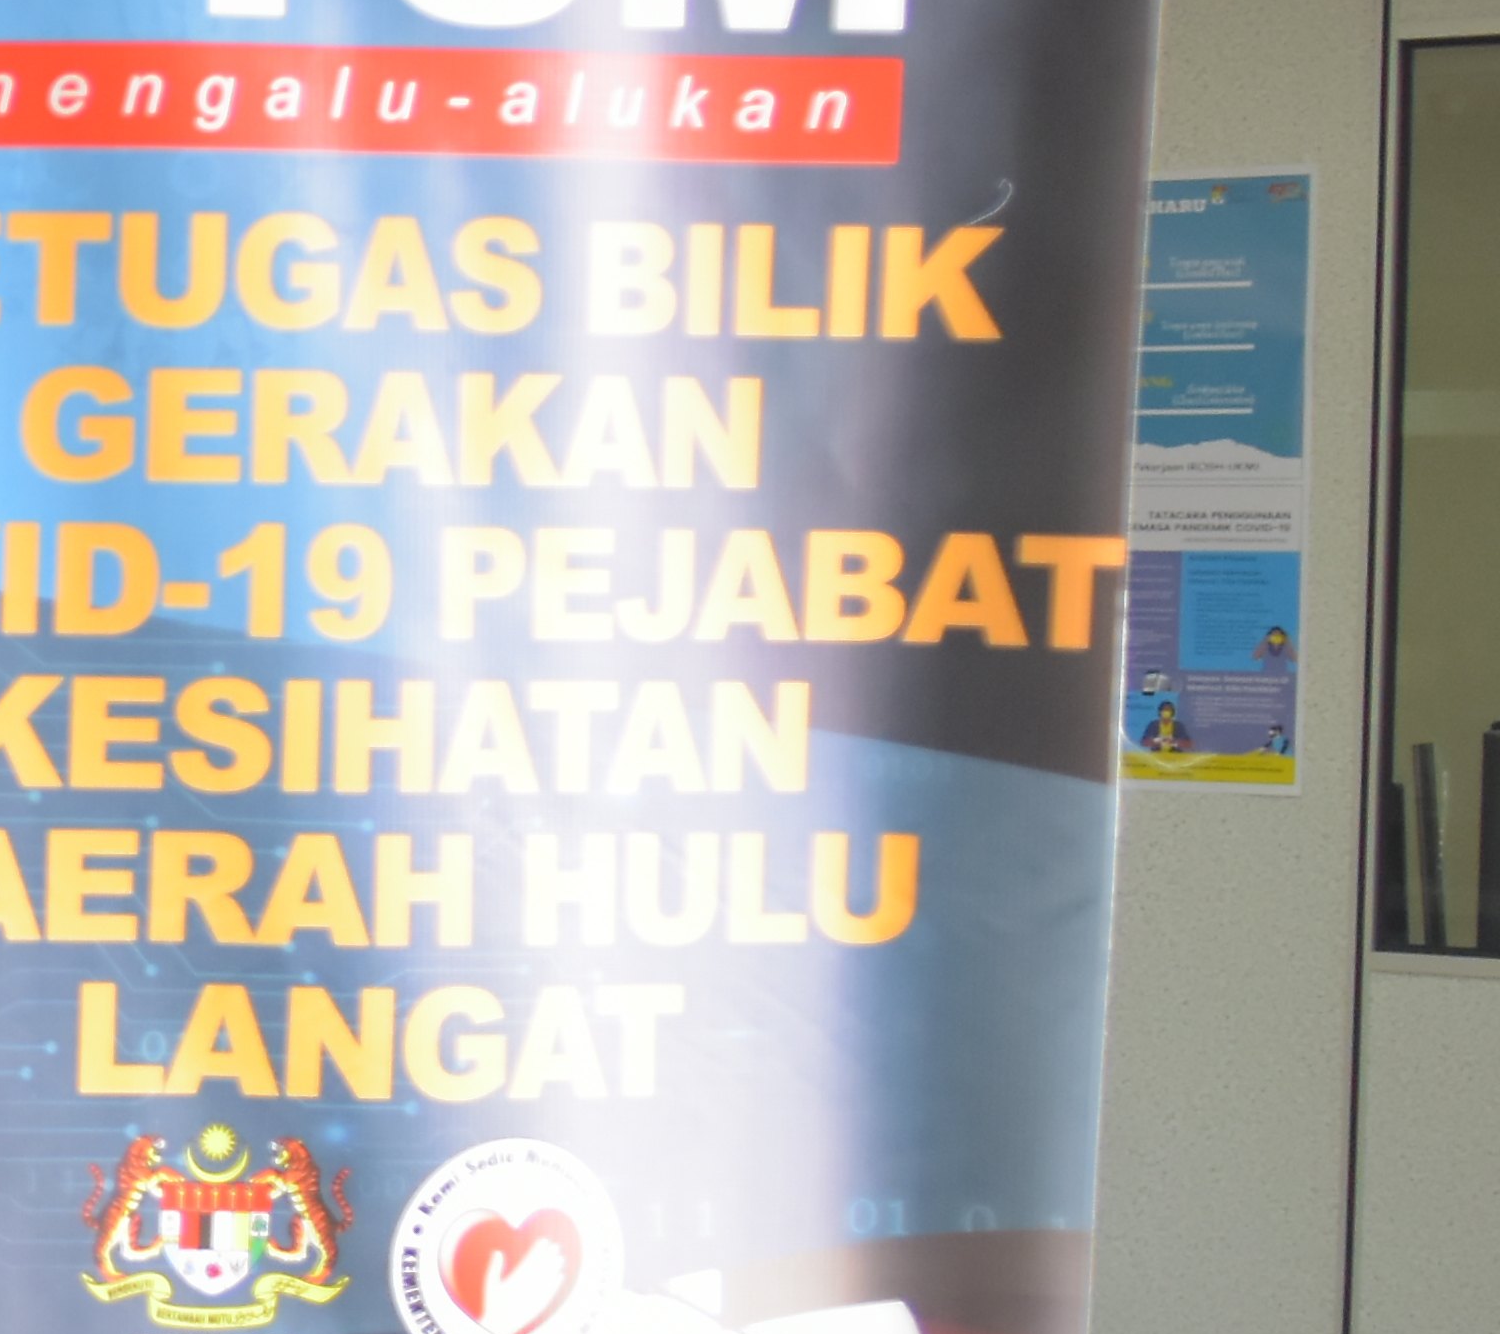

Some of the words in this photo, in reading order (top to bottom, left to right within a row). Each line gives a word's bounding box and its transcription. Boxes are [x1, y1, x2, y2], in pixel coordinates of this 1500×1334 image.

[584, 221, 1005, 342] BILIK
[20, 364, 764, 490] GERAKAN
[1234, 523, 1291, 533] COVID-19
[438, 527, 1128, 652] PEJABAT
[522, 831, 922, 948] HULU
[74, 982, 686, 1101] LANGAT
